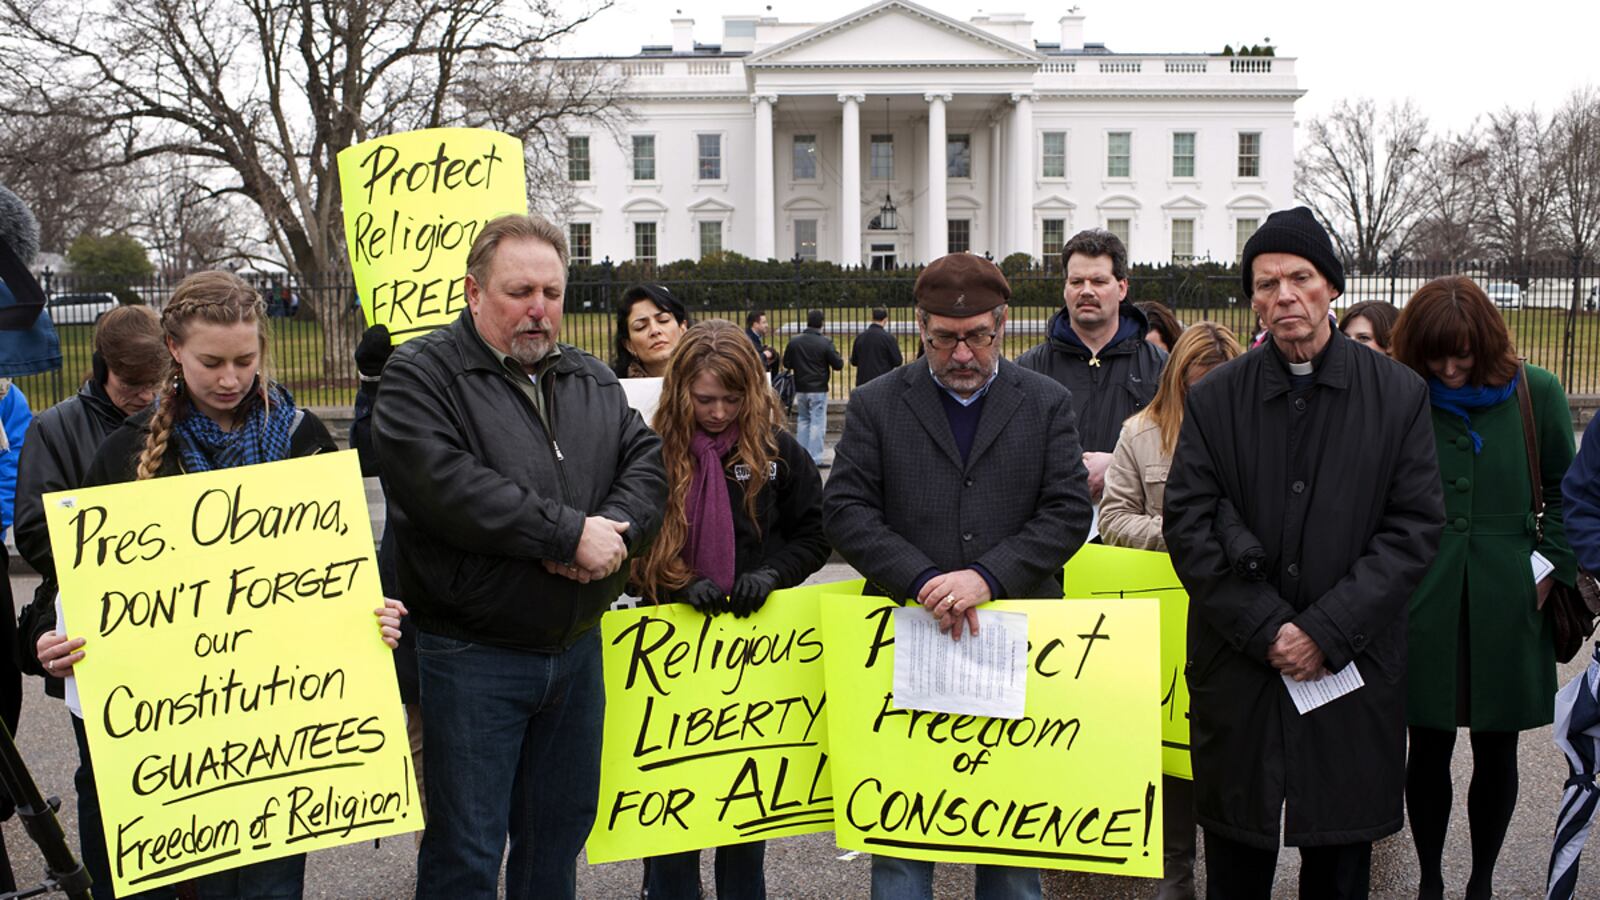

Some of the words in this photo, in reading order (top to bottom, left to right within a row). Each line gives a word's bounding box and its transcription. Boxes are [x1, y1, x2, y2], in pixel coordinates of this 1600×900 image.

[360, 142, 502, 204] Protect
[355, 210, 488, 272] Religiou
[372, 276, 466, 324] FREE
[70, 505, 176, 569] Pres.
[192, 485, 348, 546] Obama,
[100, 580, 210, 637] DON'T
[226, 556, 369, 615] FORGET
[194, 628, 253, 657] our
[612, 615, 825, 696] Religious
[103, 665, 345, 739] Constitution
[633, 691, 827, 757] LIBERTY
[132, 716, 386, 797] GUARANTEES
[608, 788, 695, 831] FOR
[716, 752, 834, 822] ALL
[953, 749, 991, 775] of
[116, 815, 240, 879] Freedom
[249, 797, 280, 839] of
[287, 755, 410, 840] Religion!
[846, 777, 1156, 857] CONSCIENCE!
